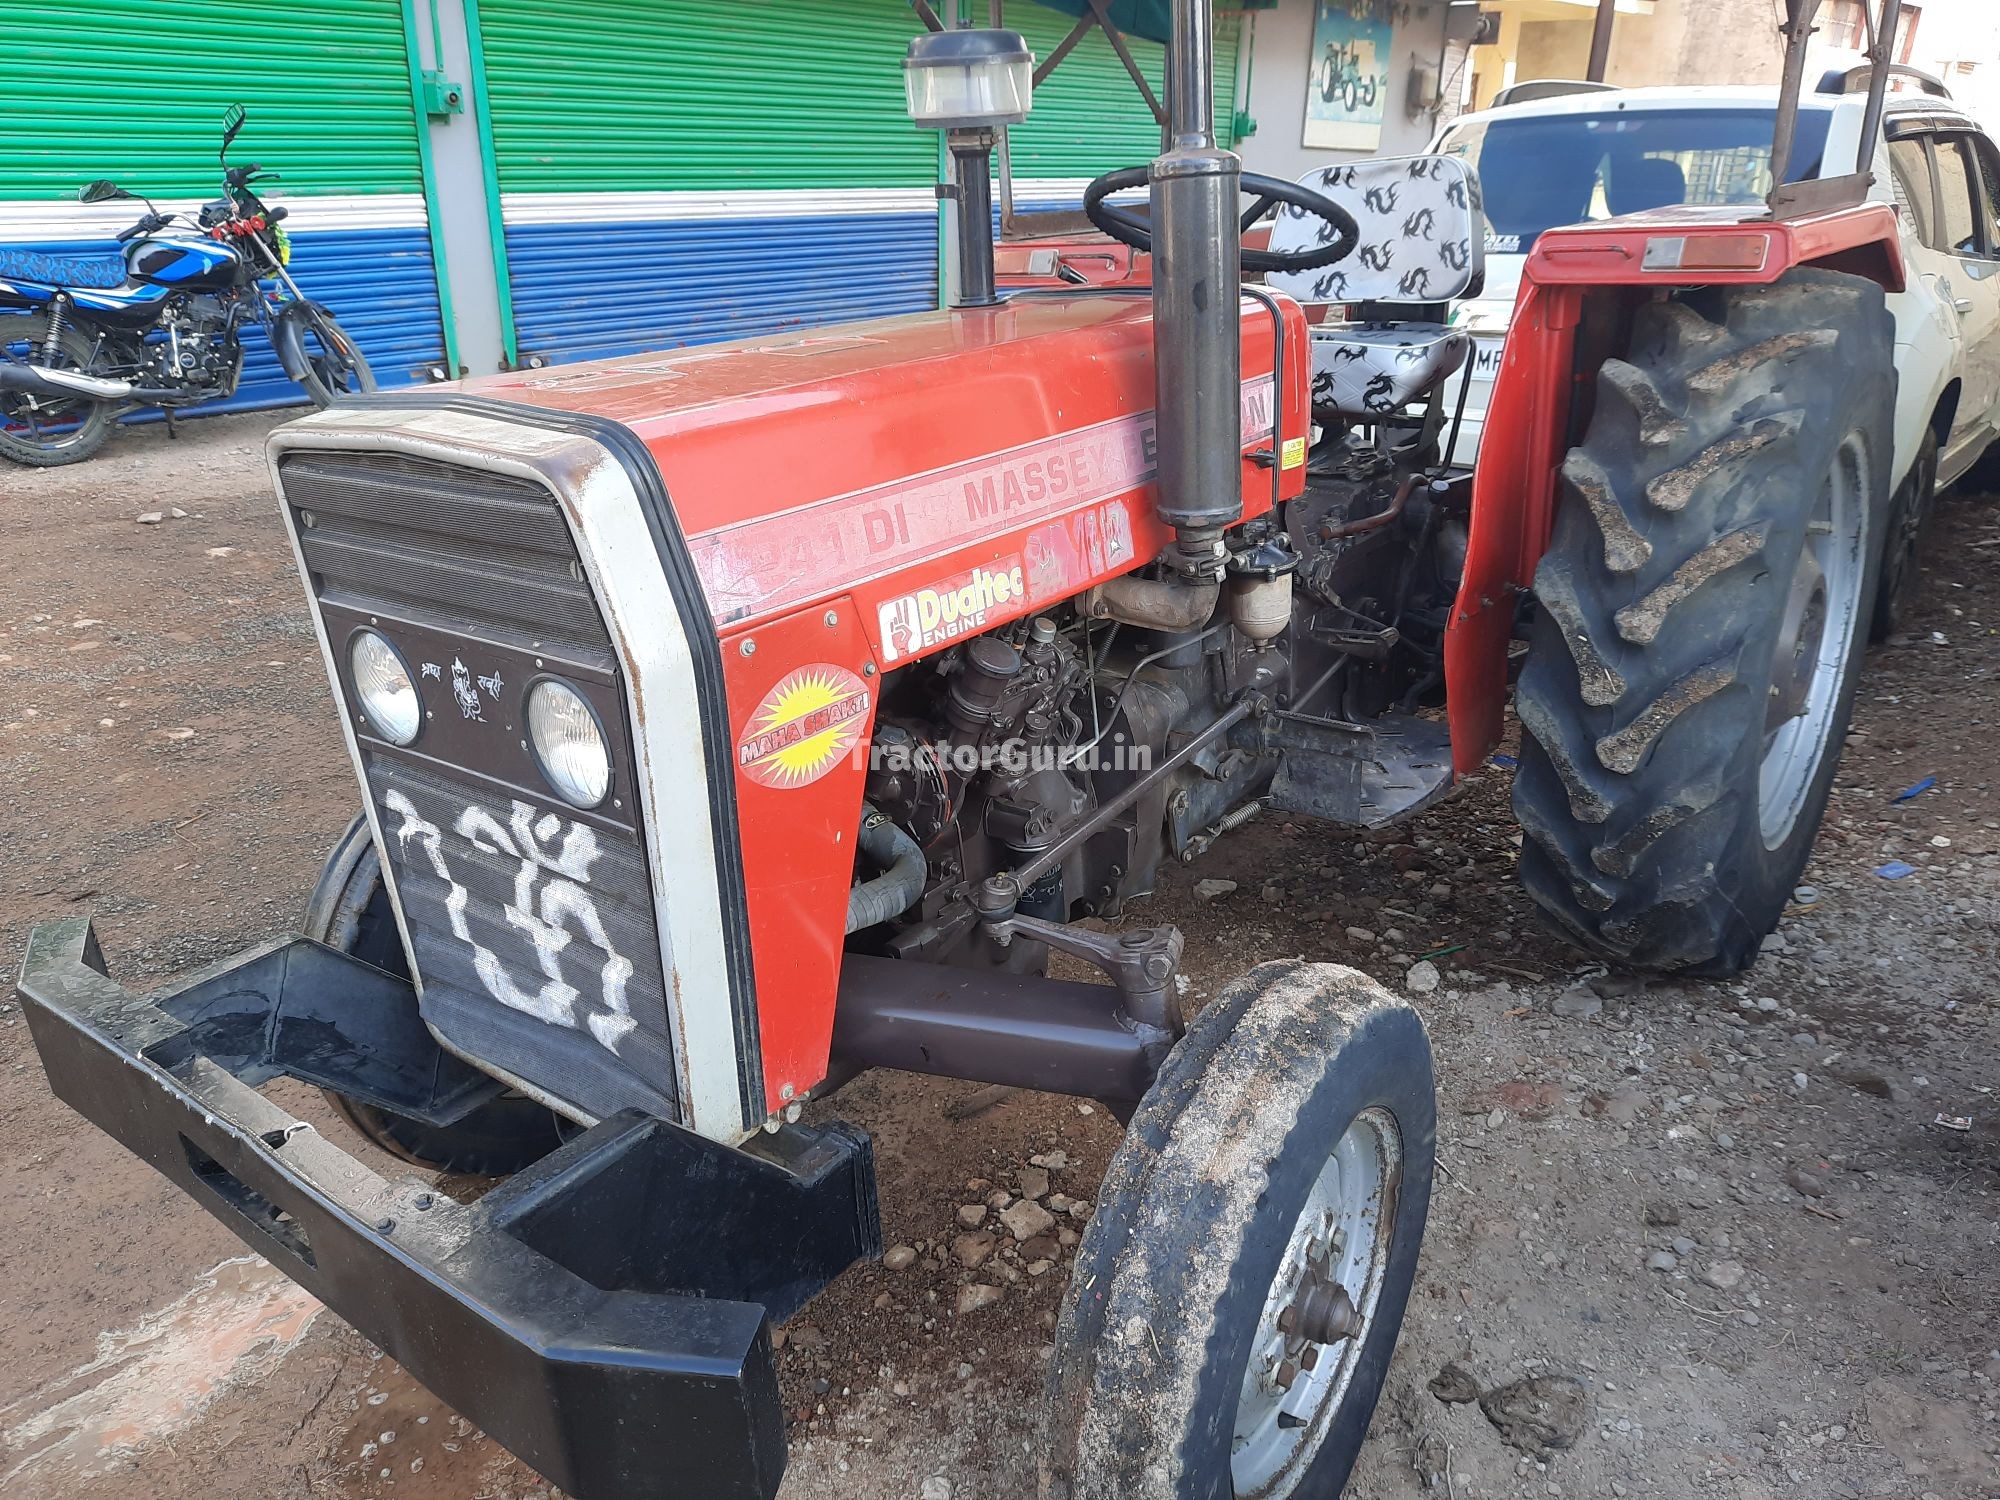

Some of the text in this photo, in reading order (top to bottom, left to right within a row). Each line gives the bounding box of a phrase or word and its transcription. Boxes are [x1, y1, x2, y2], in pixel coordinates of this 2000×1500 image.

[863, 503, 910, 554] DI
[963, 442, 1106, 521] MASSEY
[916, 566, 1024, 633] Dualtec
[921, 611, 986, 648] ENGINE
[740, 691, 870, 765] MAHA SHAKTI
